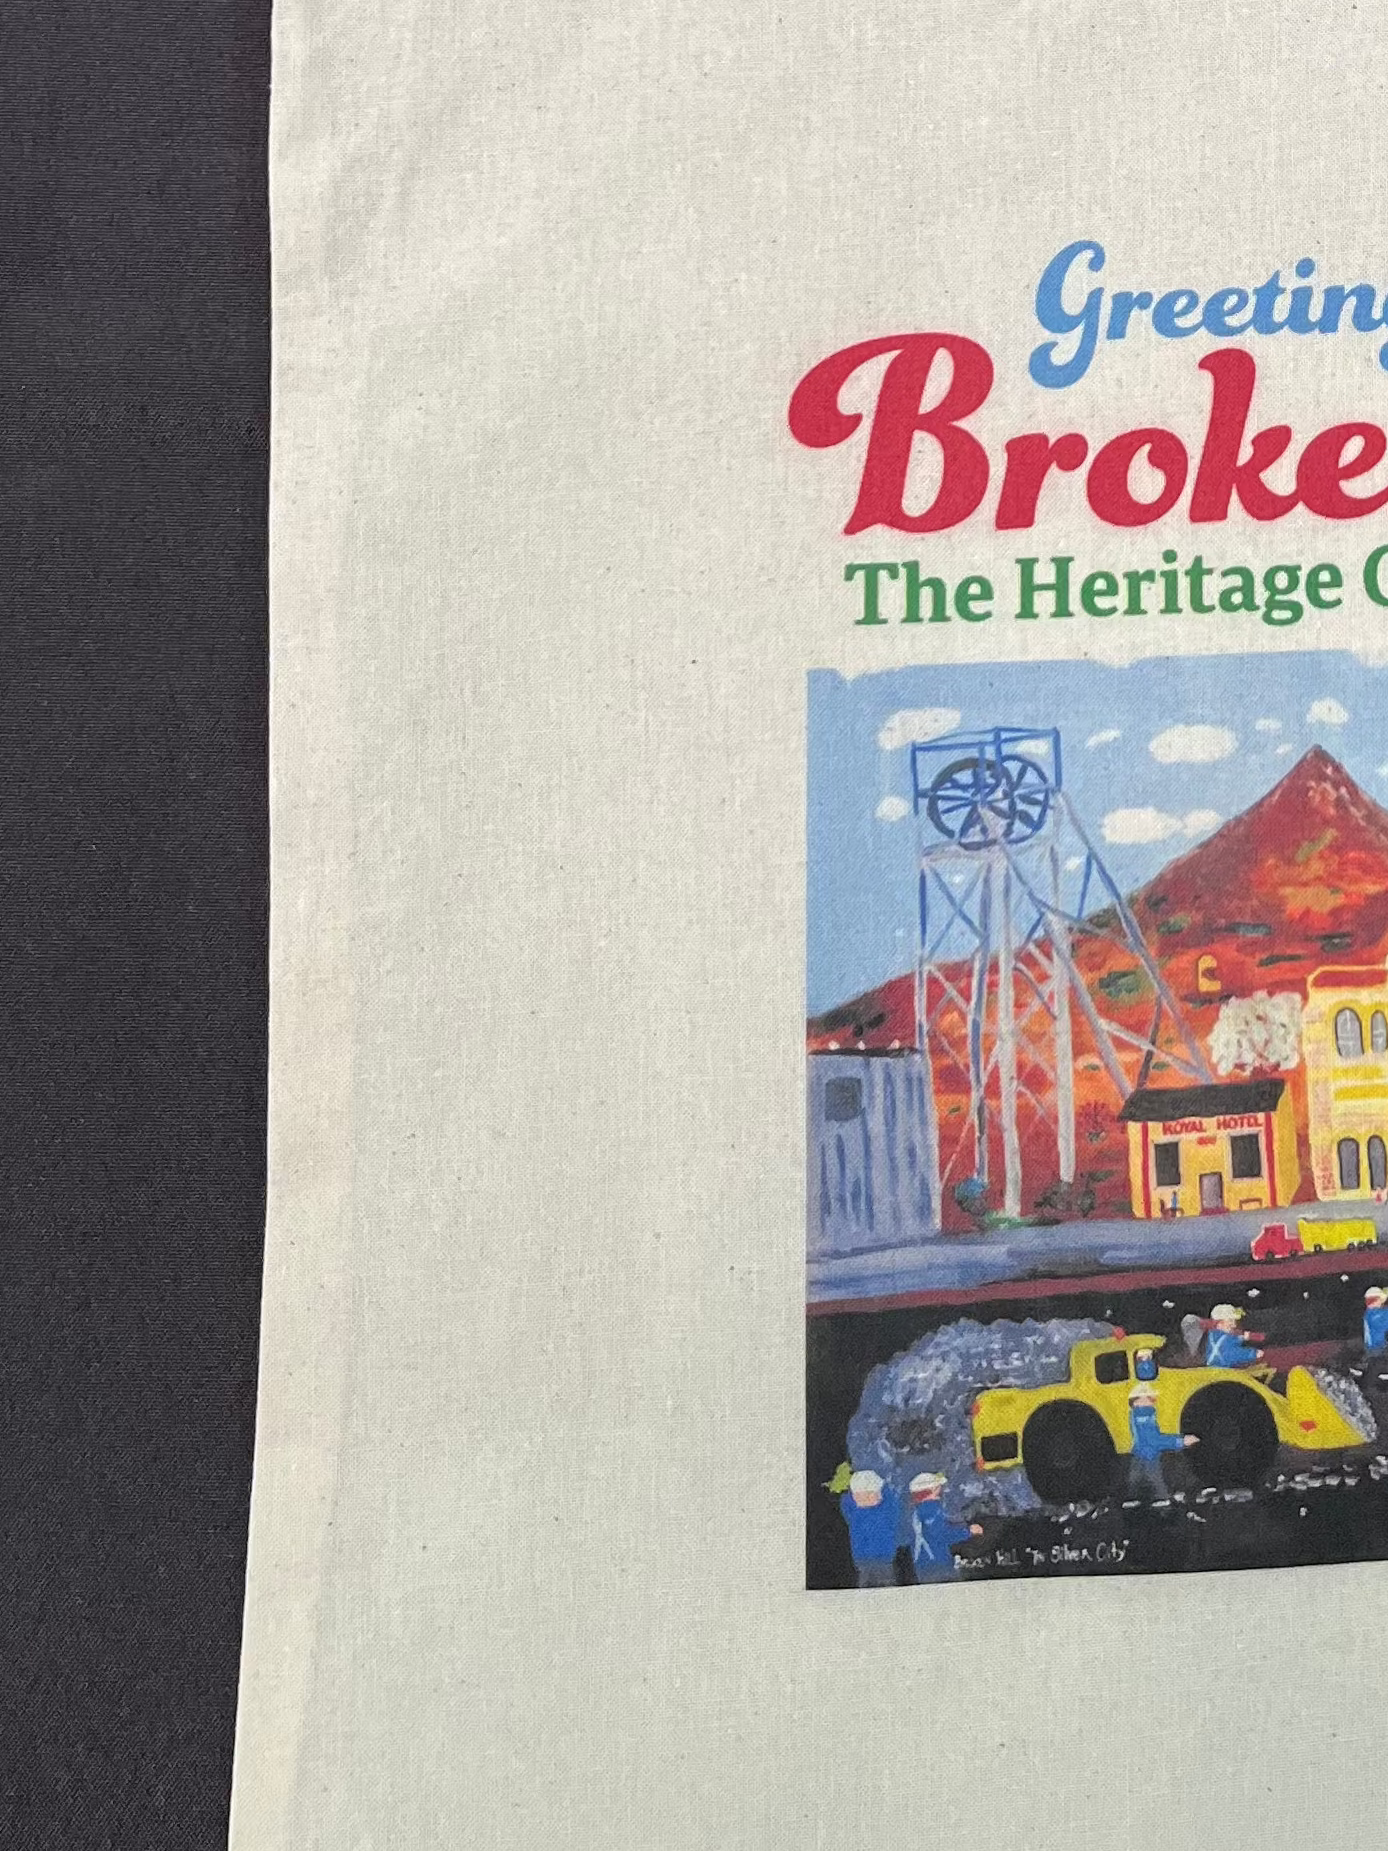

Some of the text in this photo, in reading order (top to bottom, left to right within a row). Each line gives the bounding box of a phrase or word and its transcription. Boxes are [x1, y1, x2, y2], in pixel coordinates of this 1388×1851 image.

[845, 562, 994, 626] The
[1015, 550, 1343, 626] Heritage
[1162, 1115, 1263, 1136] ROYAL HOTEL
